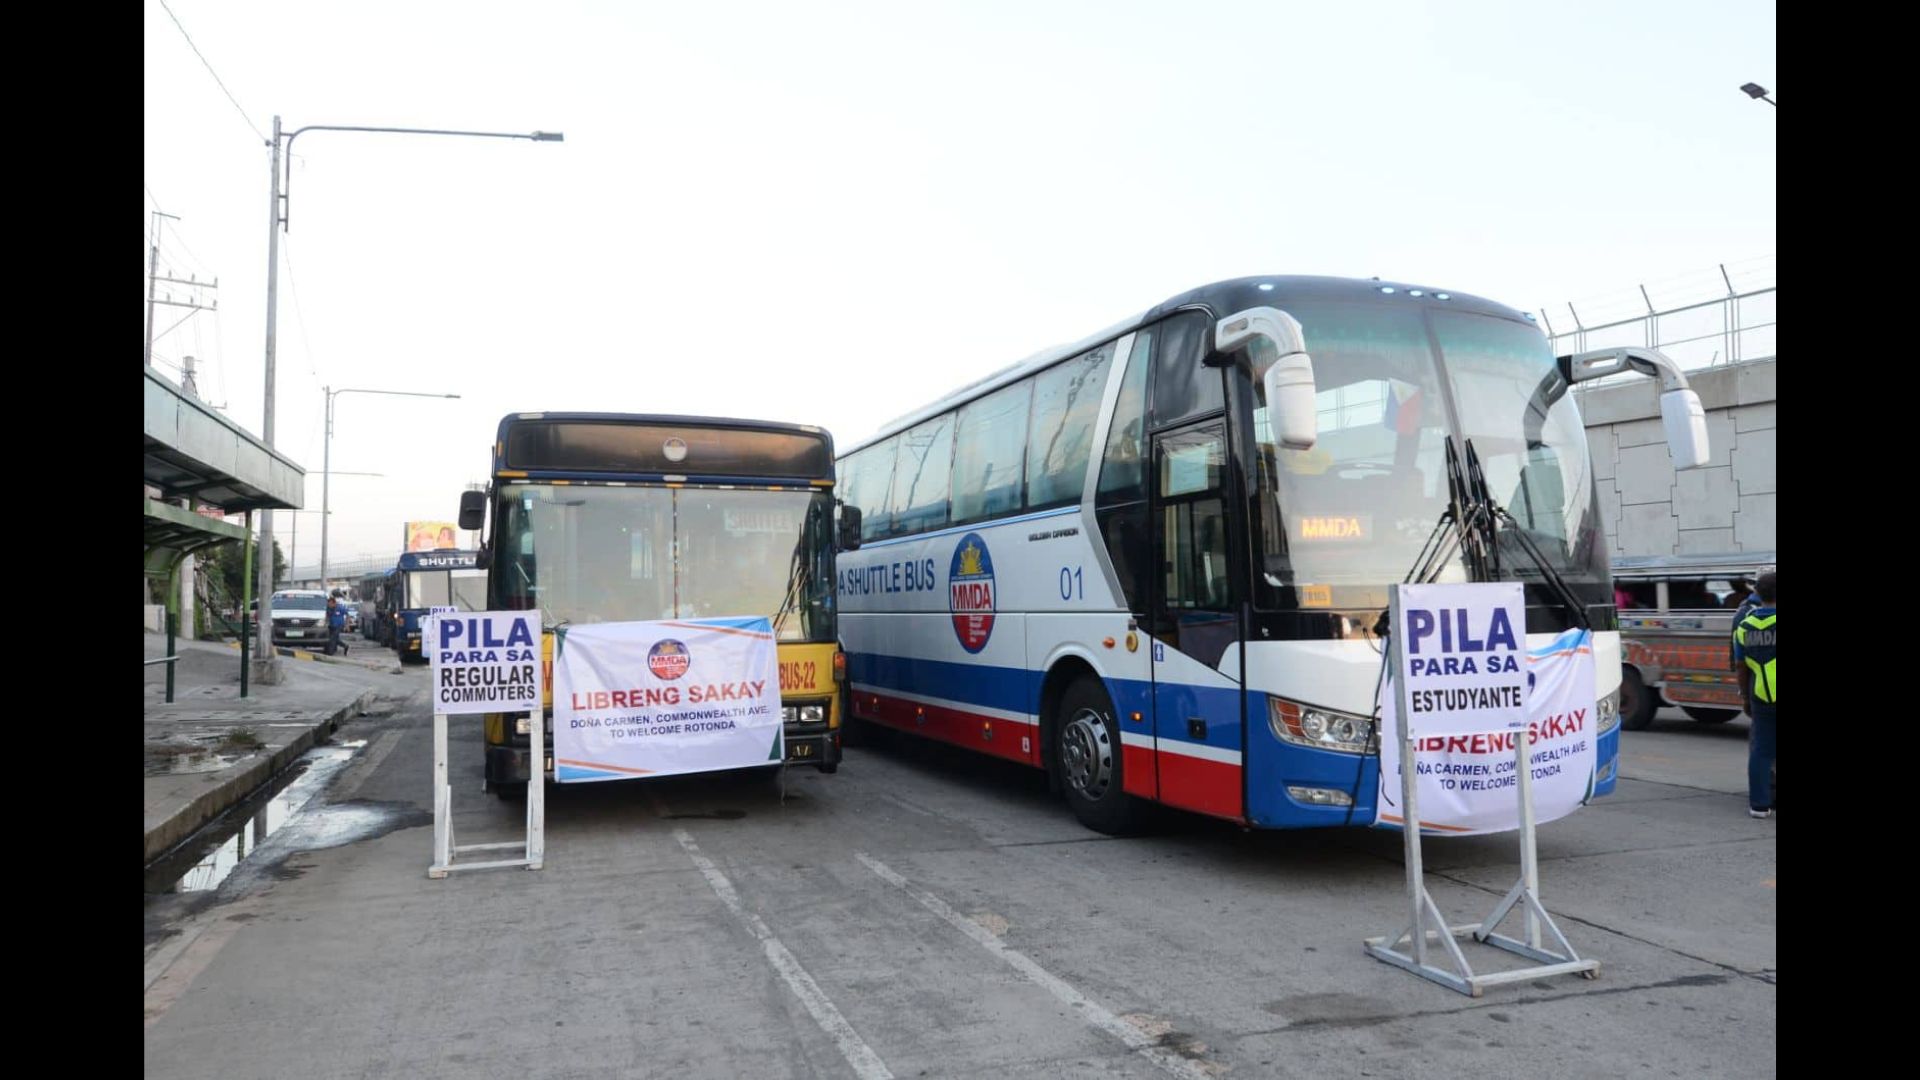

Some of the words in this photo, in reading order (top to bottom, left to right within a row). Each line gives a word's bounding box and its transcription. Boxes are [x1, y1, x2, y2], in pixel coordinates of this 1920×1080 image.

[1302, 518, 1361, 537] MMDA
[847, 563, 900, 596] SHUTTLE
[905, 558, 935, 591] BUS
[1060, 566, 1083, 600] 01
[952, 582, 992, 610] MMDA
[440, 618, 534, 649] PILA
[1407, 607, 1517, 654] PILA
[440, 651, 498, 663] PARA
[506, 649, 535, 661] SA
[651, 655, 687, 667] MMDA
[1410, 657, 1477, 676] PARA
[1487, 655, 1519, 673] SA
[440, 665, 535, 687] REGULAR
[779, 662, 816, 689] BUS-22
[440, 685, 536, 703] COMMUTERS
[572, 686, 680, 711] LIBRENG
[688, 680, 765, 703] SAKAY
[1412, 686, 1522, 712] ESTUDYANTE
[570, 717, 601, 729] DOÑA
[604, 715, 654, 727] CARMEN,
[656, 708, 746, 723] COMMONWEALTH
[611, 728, 625, 738] TO
[627, 726, 681, 737] WELCOME
[684, 720, 736, 733] ROTONDA
[1440, 779, 1456, 790] TO
[1460, 775, 1516, 791] WELCOME
